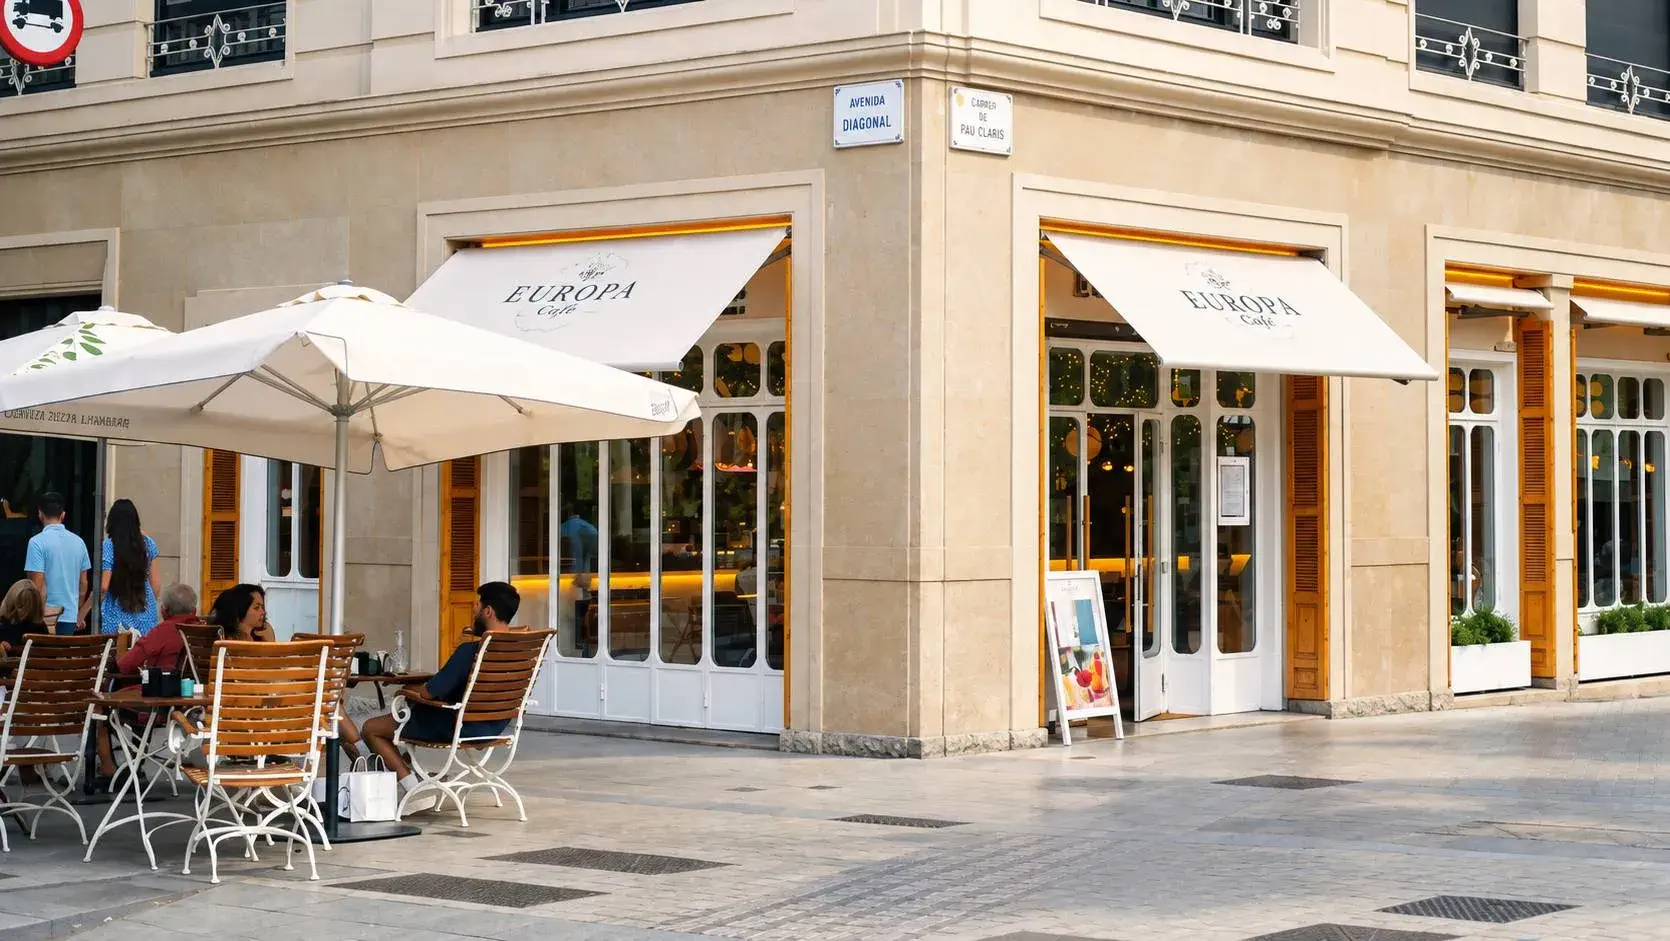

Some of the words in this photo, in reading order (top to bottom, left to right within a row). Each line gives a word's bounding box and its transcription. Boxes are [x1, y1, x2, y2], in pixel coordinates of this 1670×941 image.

[850, 95, 886, 109] AVENIDA
[843, 115, 892, 132] DIAGONAL
[978, 111, 988, 122] DE
[960, 123, 976, 136] PAU
[977, 126, 1005, 140] CLARIS
[503, 280, 638, 304] EUROPA
[1179, 289, 1302, 317] EUROPA
